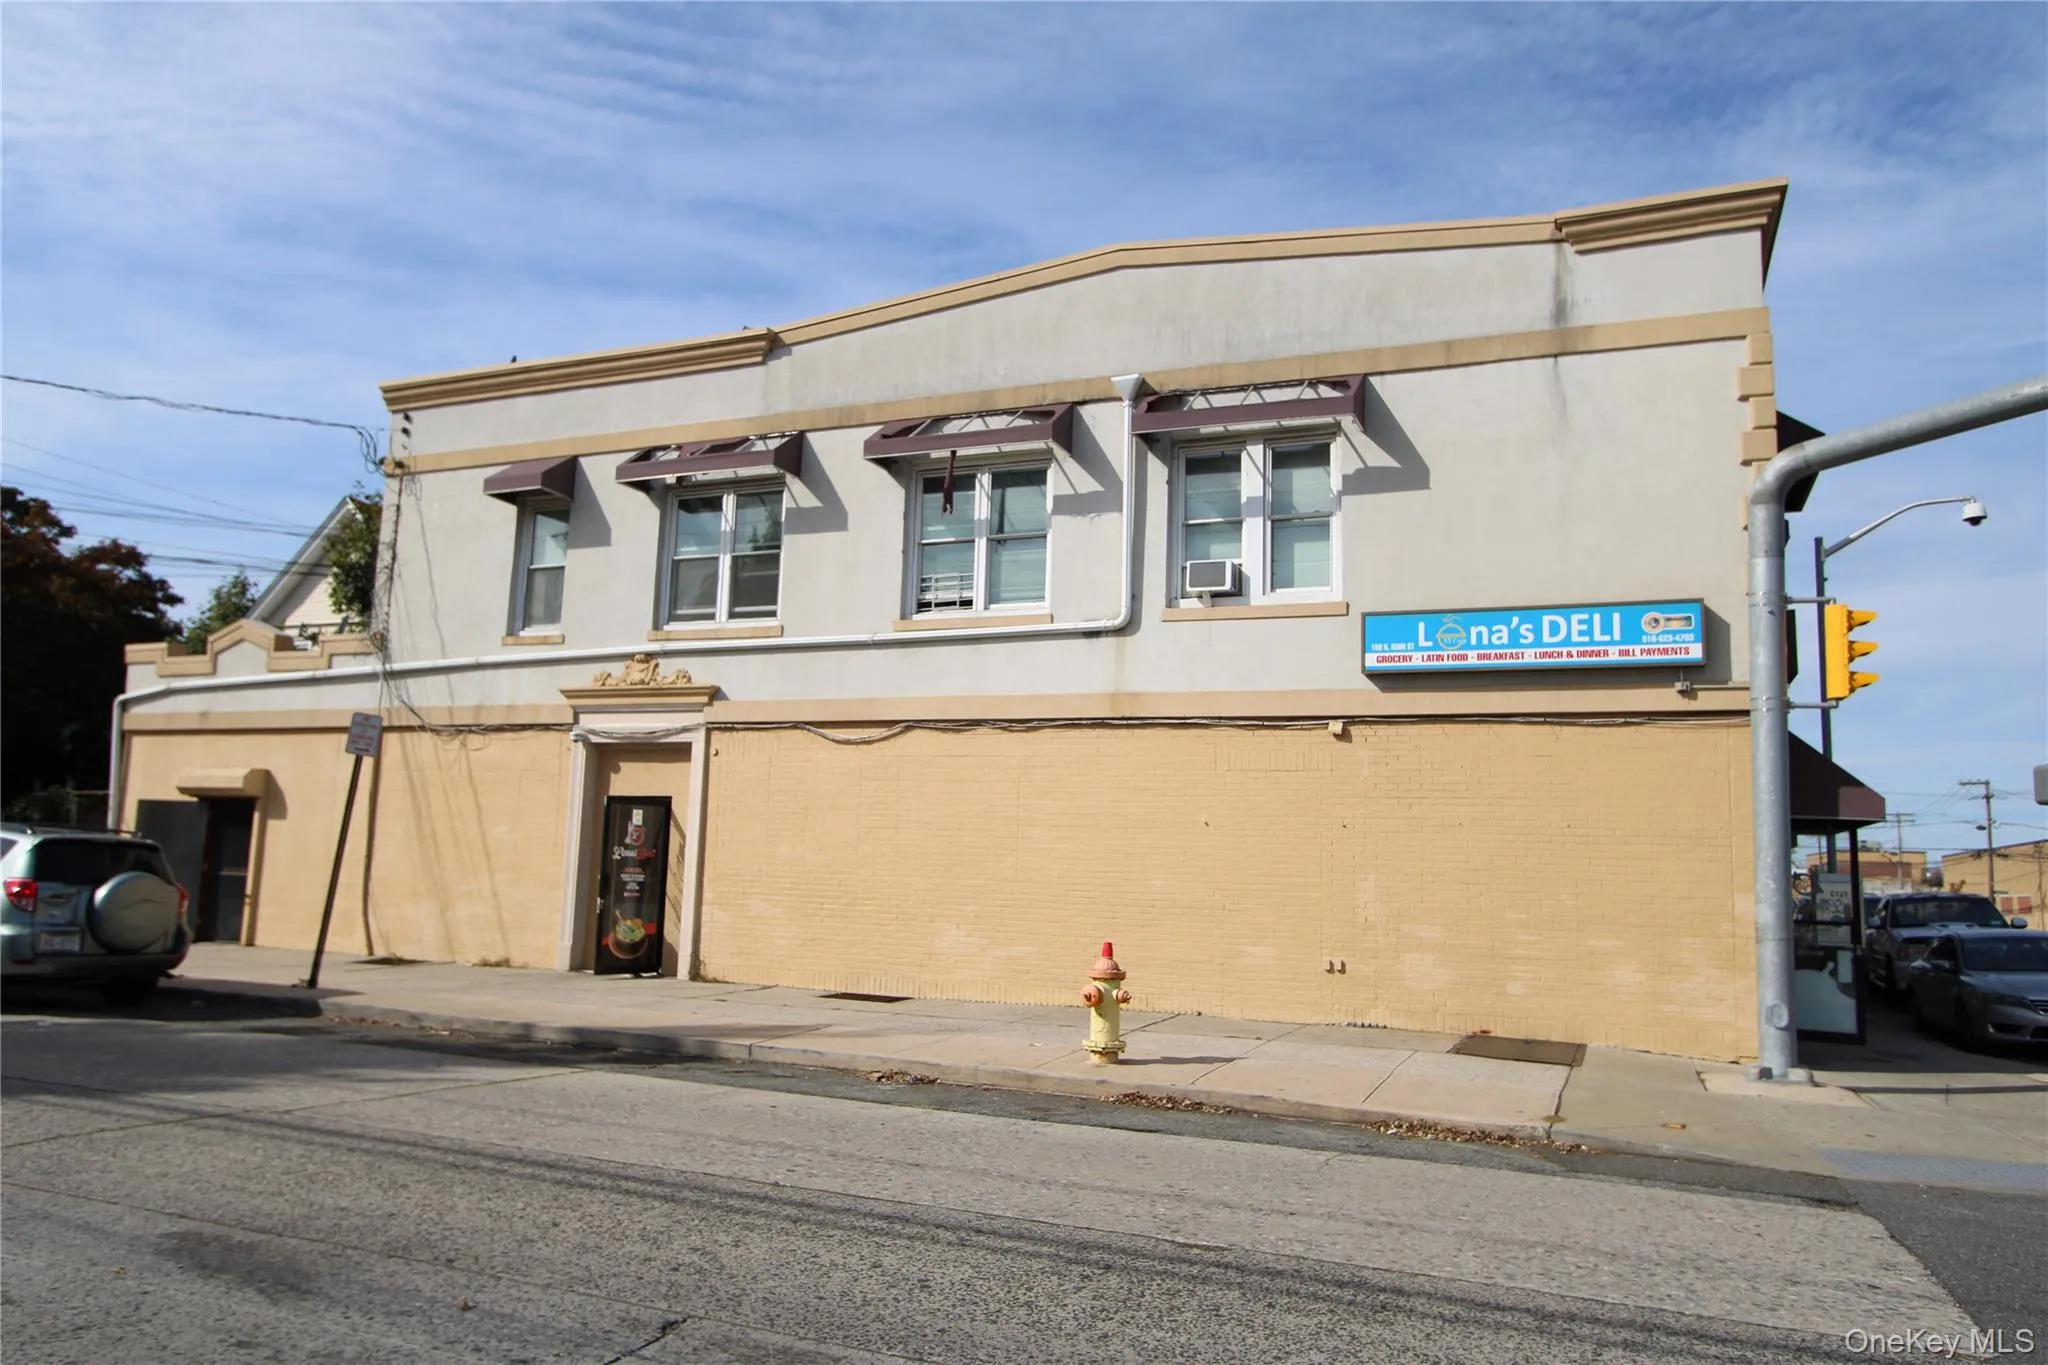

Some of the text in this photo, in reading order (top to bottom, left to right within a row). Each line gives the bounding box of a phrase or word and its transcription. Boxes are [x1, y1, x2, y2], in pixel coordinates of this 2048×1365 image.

[1541, 612, 1621, 643] DELI
[1376, 646, 1690, 664] GROCERY LATIN FOOD BREAKFAST LUNCH & DINNER BILL PAYMENTS
